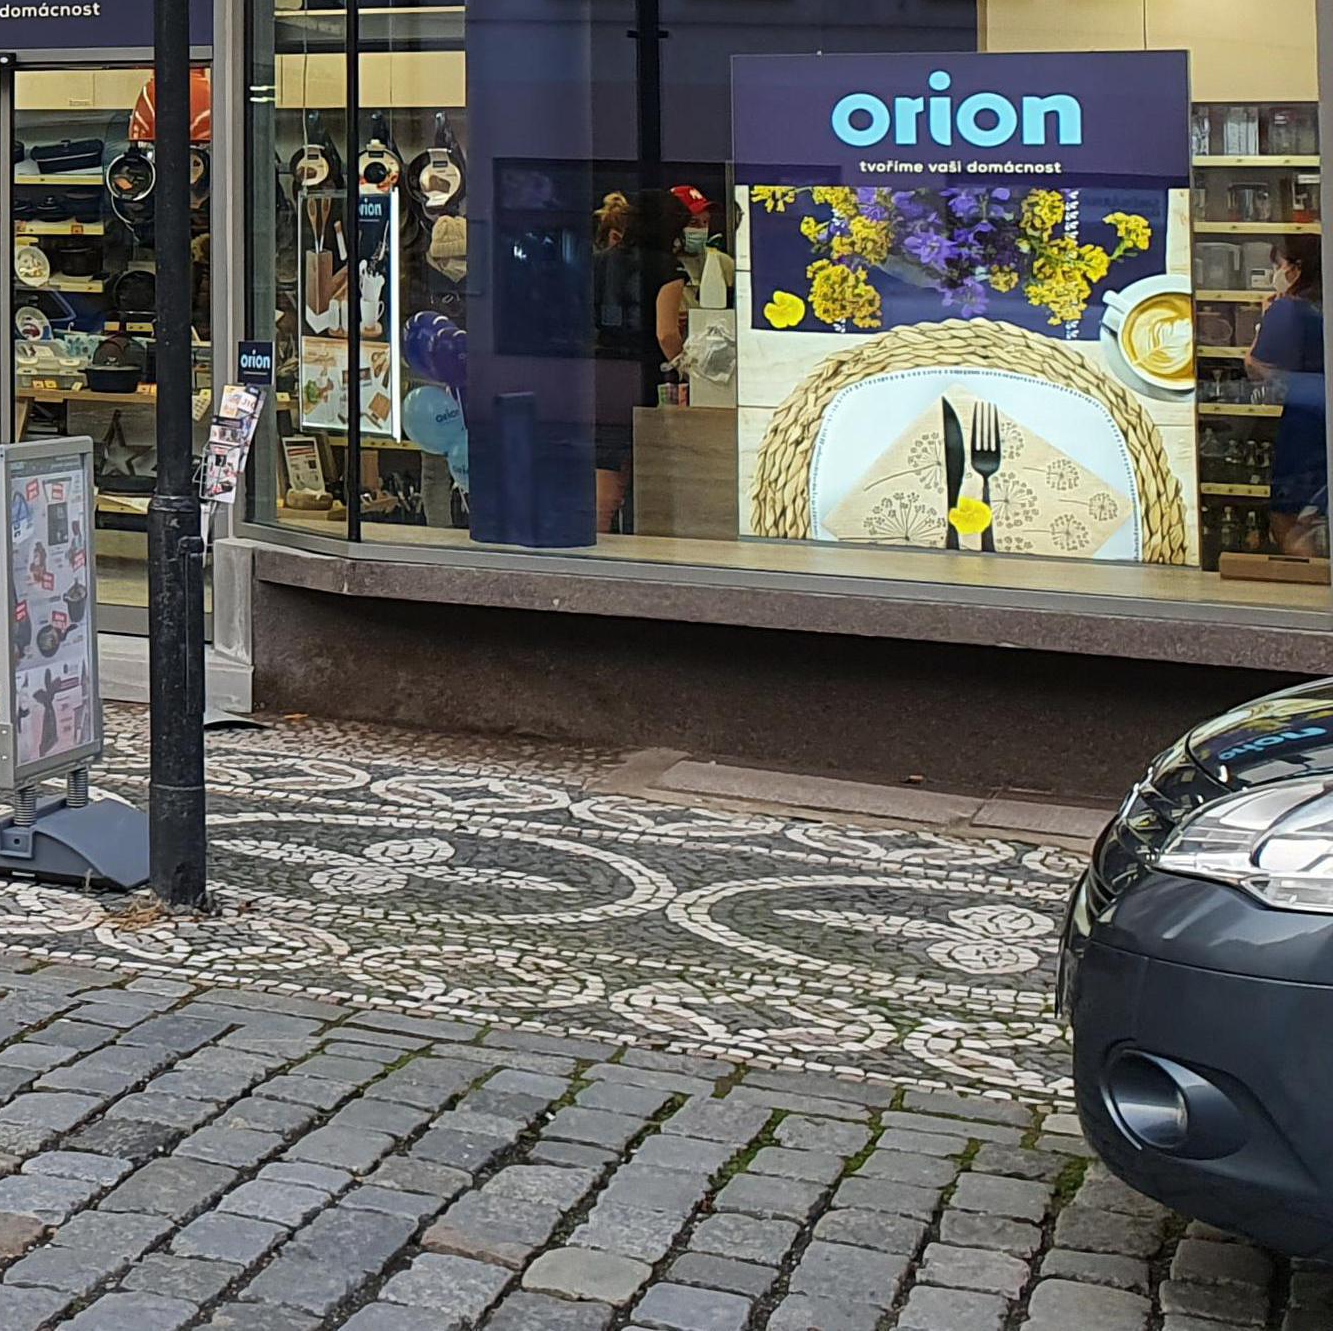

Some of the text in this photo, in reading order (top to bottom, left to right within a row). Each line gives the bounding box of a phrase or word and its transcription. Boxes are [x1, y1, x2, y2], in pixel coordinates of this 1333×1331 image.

[0, 2, 101, 18] domácnost
[831, 70, 1082, 147] orion
[859, 160, 1063, 174] tvoříme vaši domácnost
[359, 197, 383, 216] rion
[240, 349, 271, 369] orion
